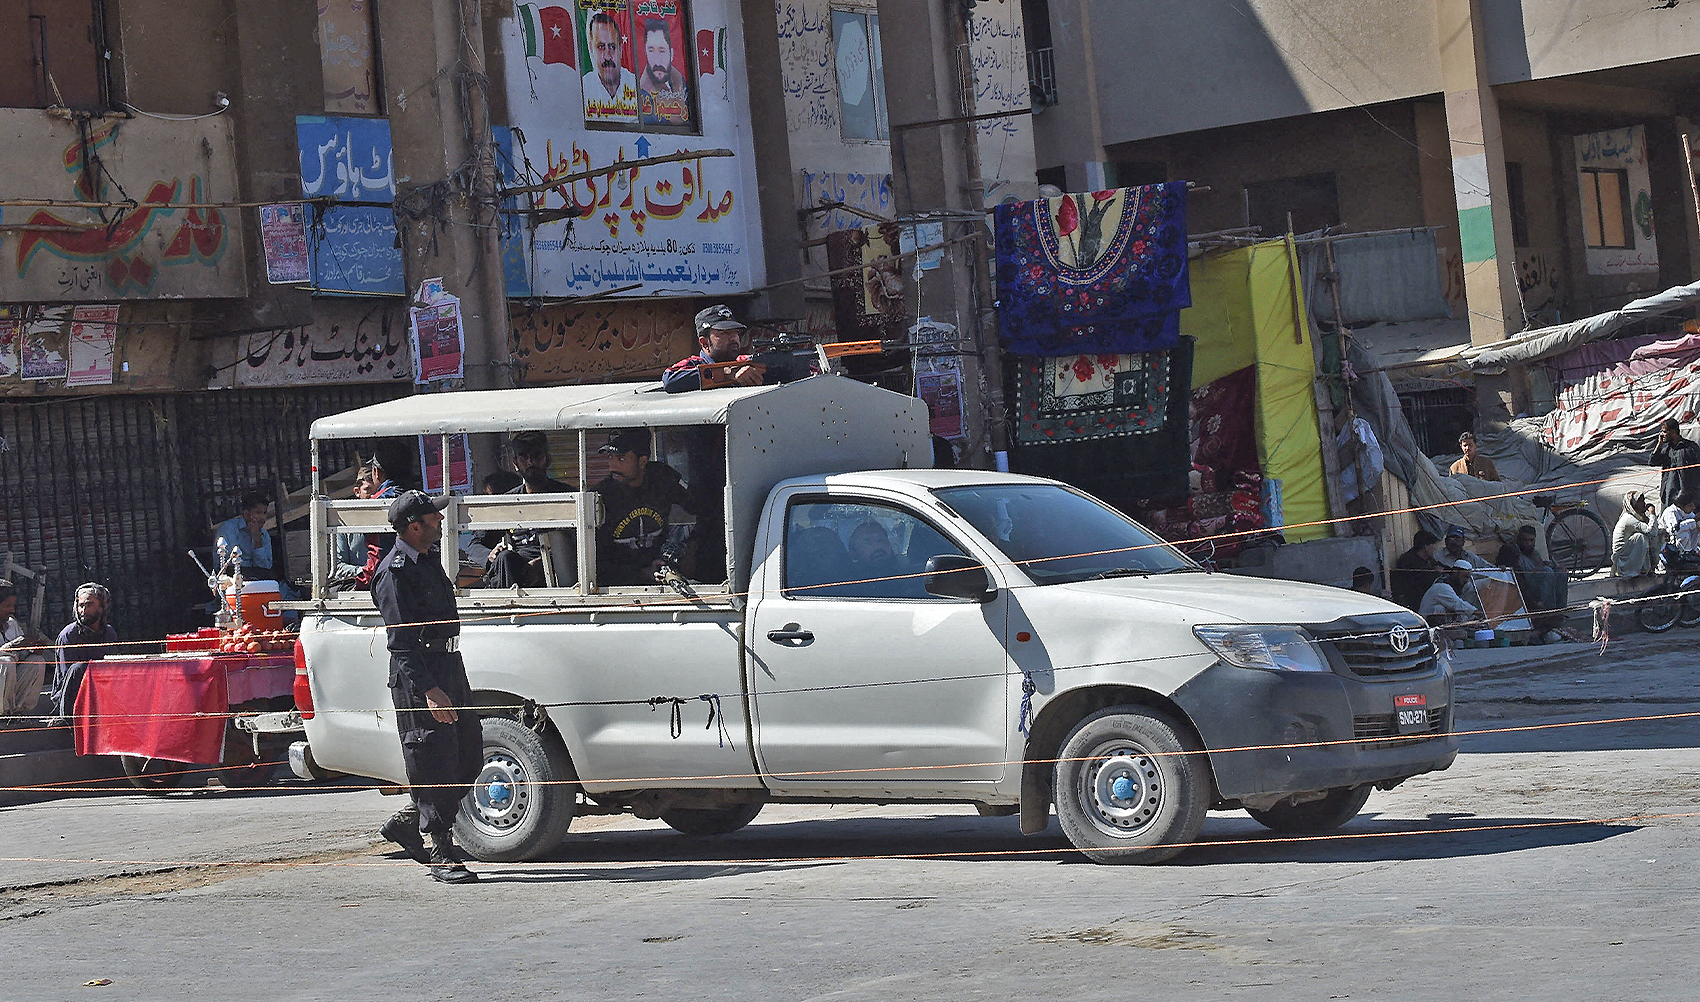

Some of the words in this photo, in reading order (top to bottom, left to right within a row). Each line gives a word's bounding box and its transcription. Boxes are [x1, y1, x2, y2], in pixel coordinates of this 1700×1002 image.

[645, 149, 735, 223] صداقت
[666, 238, 678, 254] 80
[565, 261, 593, 291] خیل
[641, 259, 692, 284] نعمت
[691, 263, 720, 285] سردار
[310, 304, 401, 374] بلینکٹ
[1403, 696, 1418, 704] POLICE
